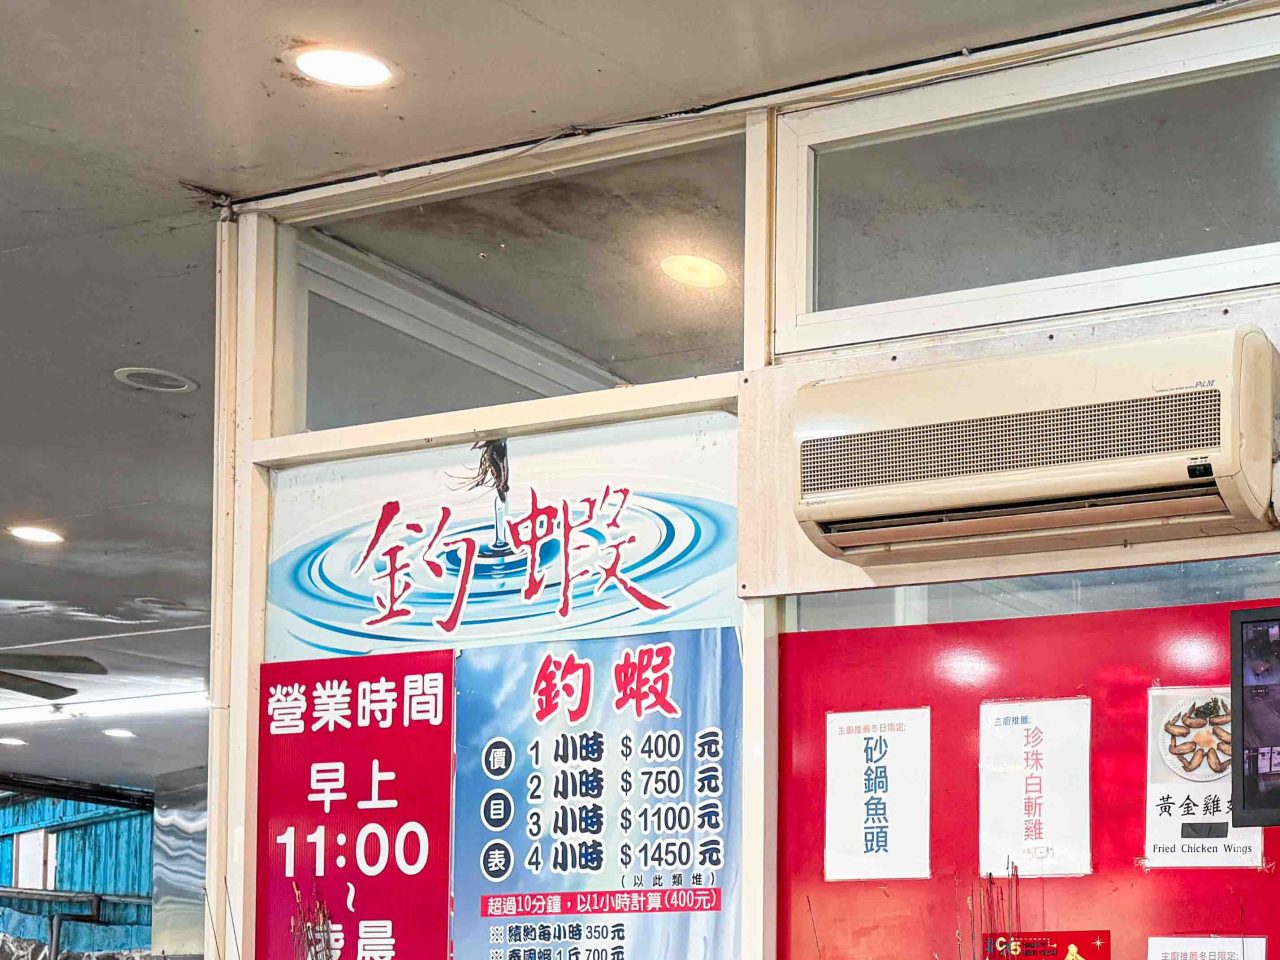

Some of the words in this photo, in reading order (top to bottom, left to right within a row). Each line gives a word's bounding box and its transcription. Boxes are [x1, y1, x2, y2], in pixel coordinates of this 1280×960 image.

[267, 672, 444, 735] 營業時間
[533, 646, 678, 722] 釣蝦
[530, 741, 539, 766] 1
[307, 759, 398, 813] 早上
[529, 774, 541, 799] 2
[863, 735, 889, 854] 砂鍋魚頭
[1023, 726, 1044, 841] 珍珠白斬雞
[529, 812, 541, 836] 3
[1156, 794, 1232, 817] 黃金雞
[275, 820, 429, 878] 11:00
[528, 846, 541, 871] 4
[1153, 843, 1176, 853] Fried
[1181, 843, 1218, 853] Chicken
[1224, 844, 1252, 855] Wings
